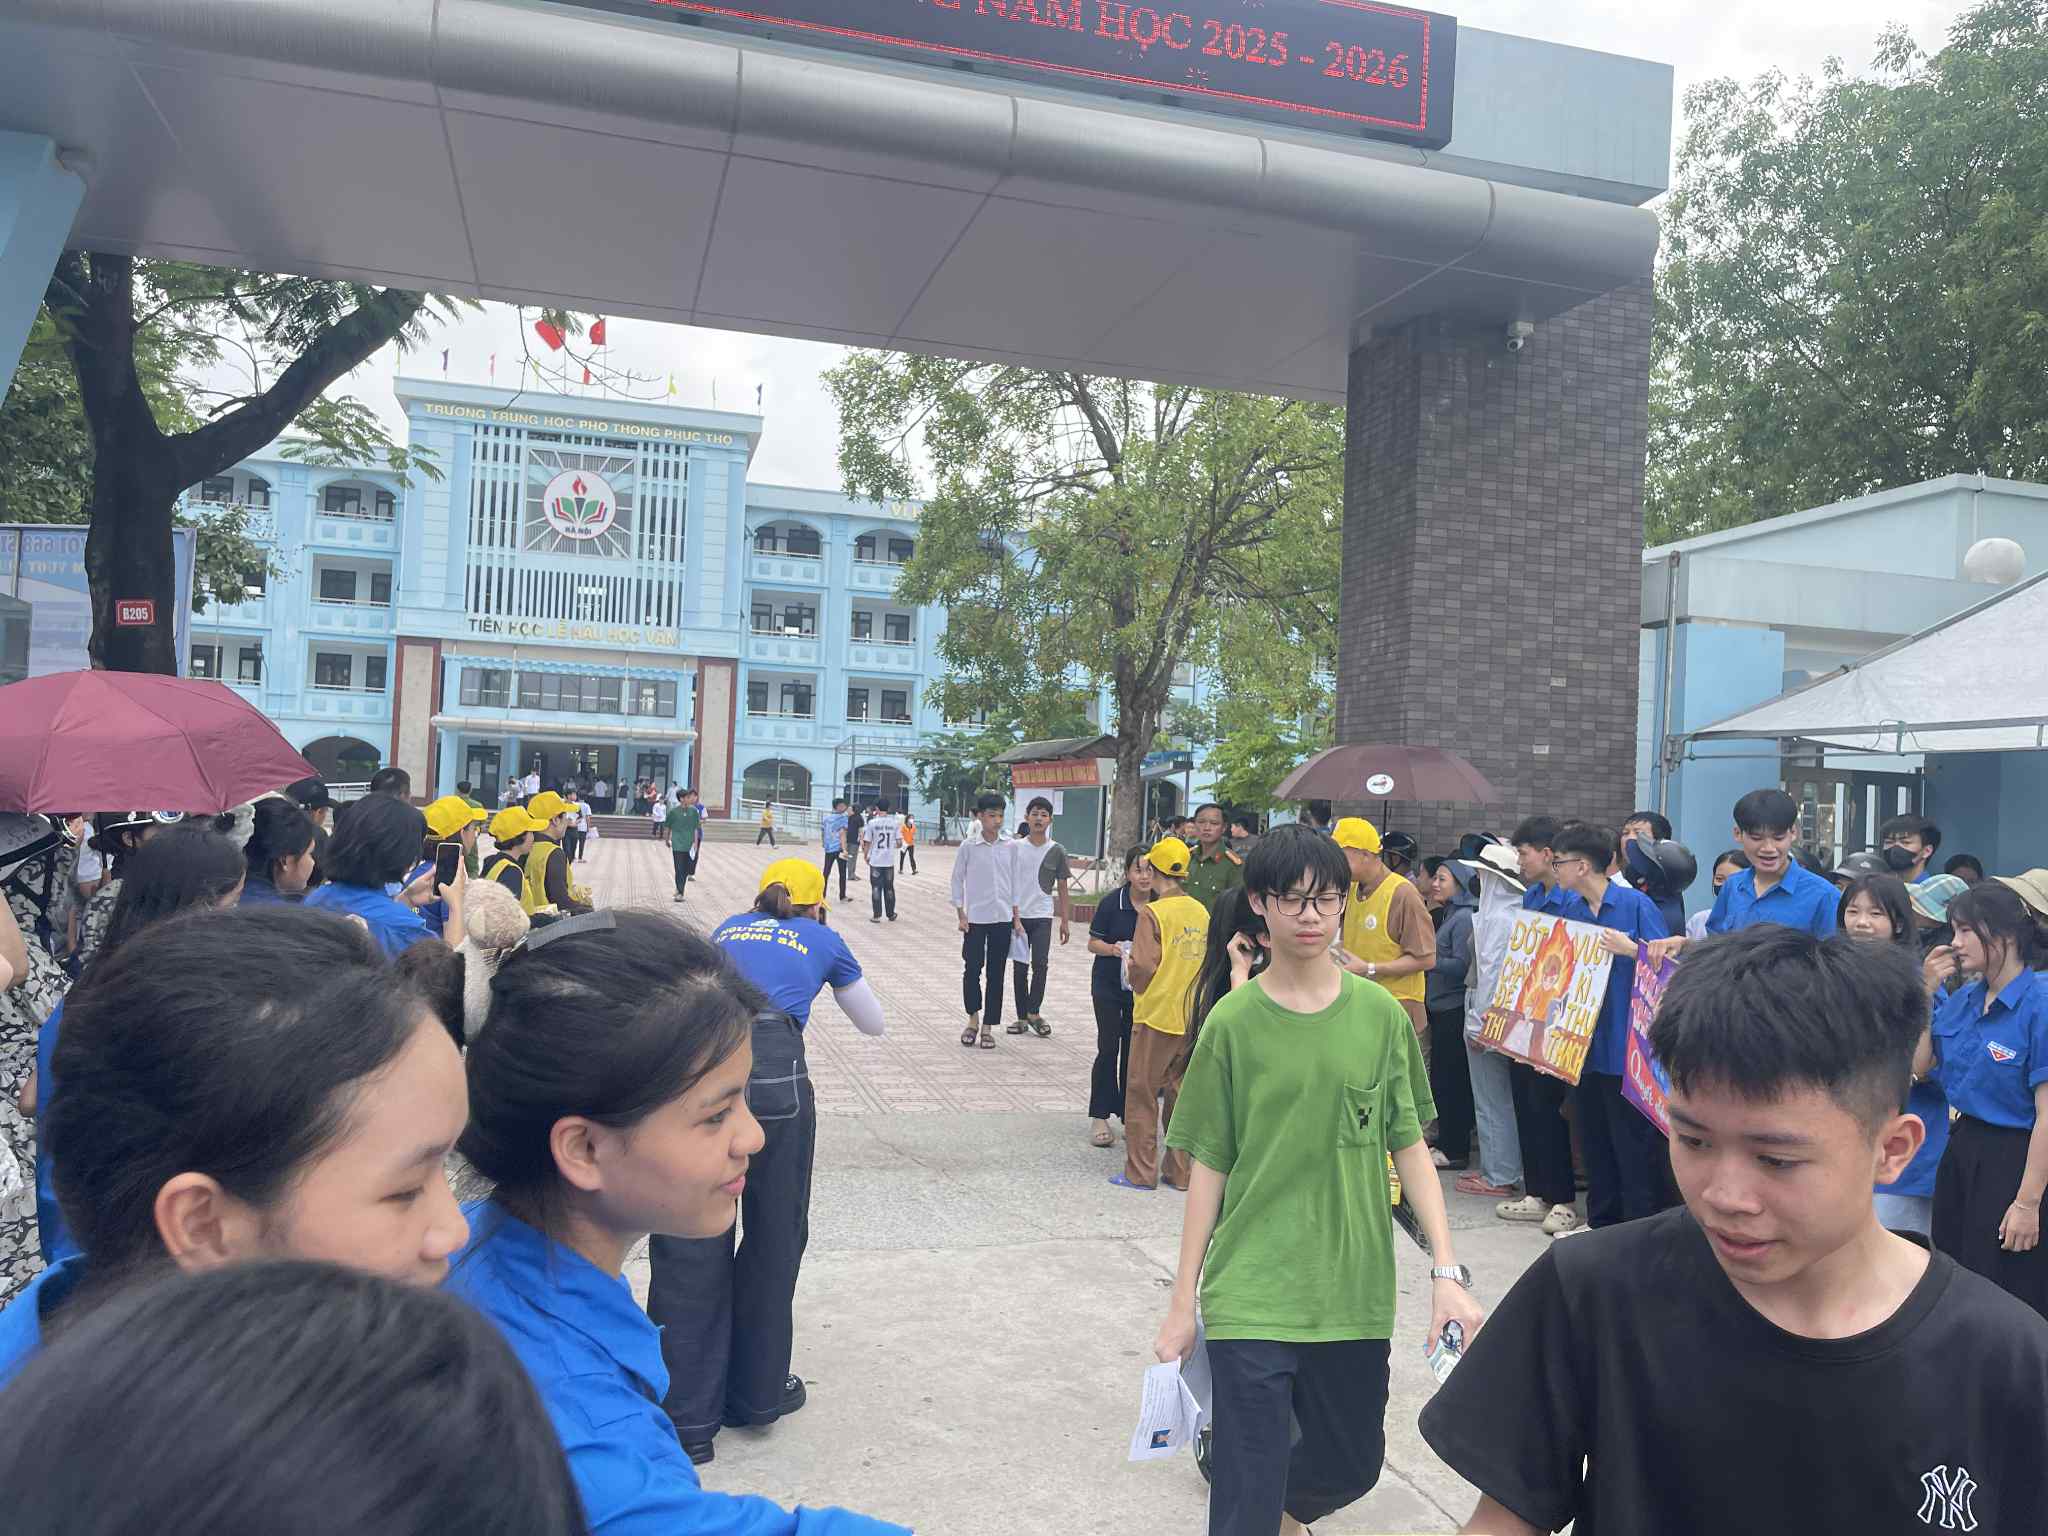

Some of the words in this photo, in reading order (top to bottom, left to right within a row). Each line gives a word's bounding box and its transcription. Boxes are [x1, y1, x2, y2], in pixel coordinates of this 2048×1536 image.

[1202, 19, 1289, 67] 2025
[1321, 41, 1409, 89] 2026
[492, 408, 538, 425] TRUNG
[123, 607, 149, 620] B205
[877, 832, 890, 848] 21
[1917, 1464, 1978, 1532] NY
